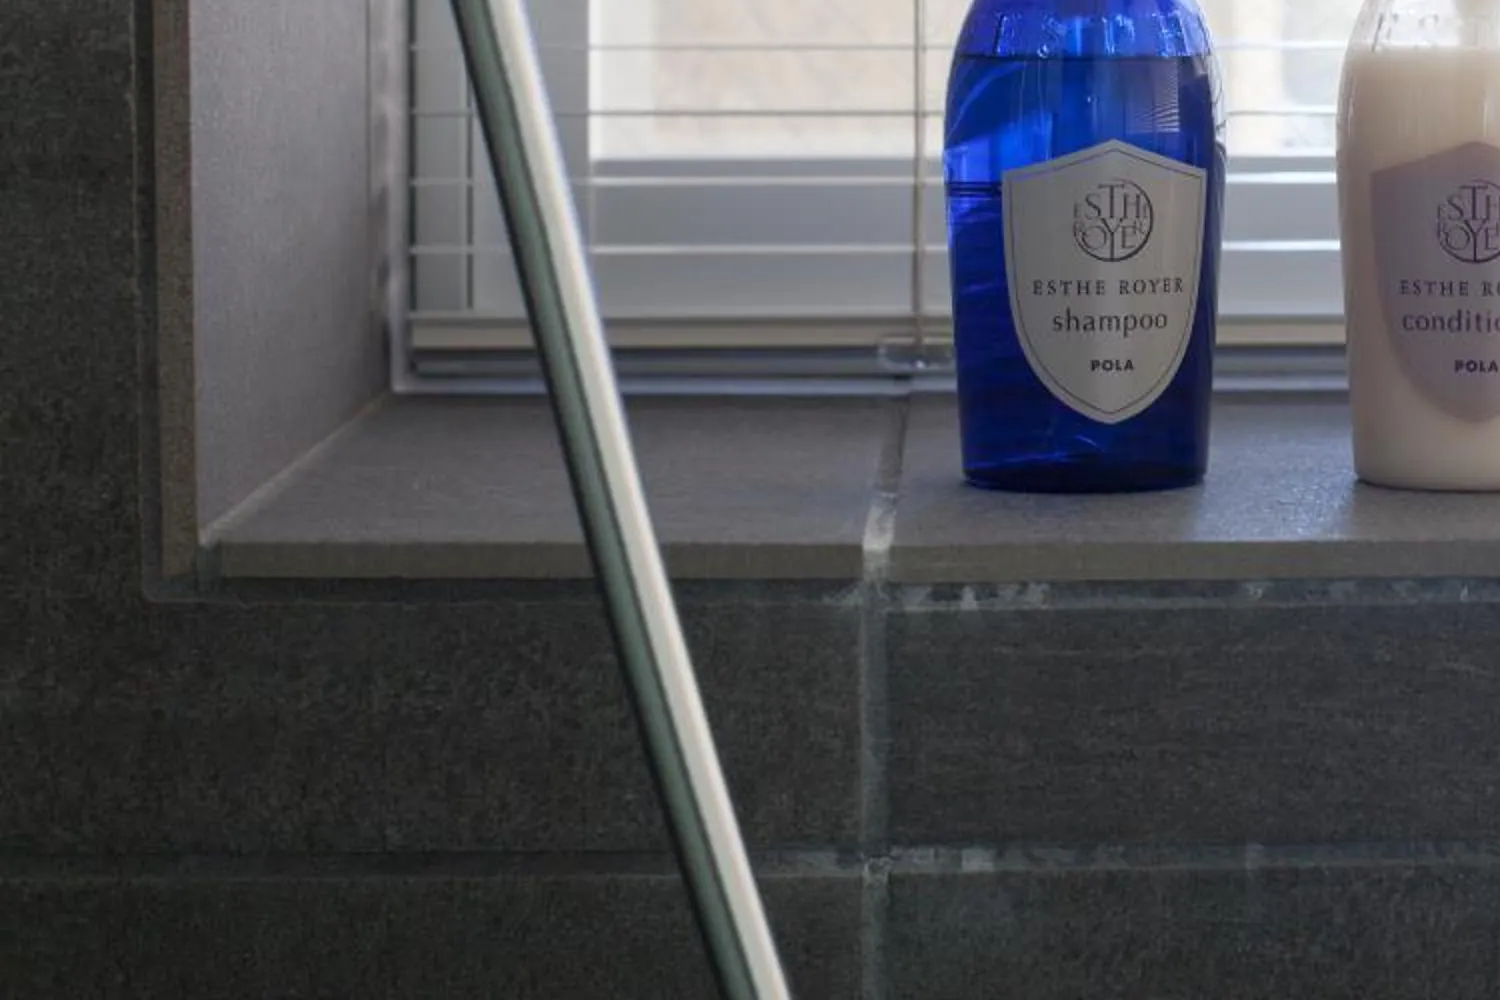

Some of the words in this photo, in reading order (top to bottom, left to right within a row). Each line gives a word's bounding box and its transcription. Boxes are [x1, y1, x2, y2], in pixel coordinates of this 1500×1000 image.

[1032, 279, 1106, 297] ESTHE
[1118, 277, 1184, 295] ROYER
[1399, 279, 1469, 297] ESTHE
[1052, 307, 1169, 338] shampoo
[1090, 359, 1135, 372] POLA
[1453, 359, 1499, 373] POLA
